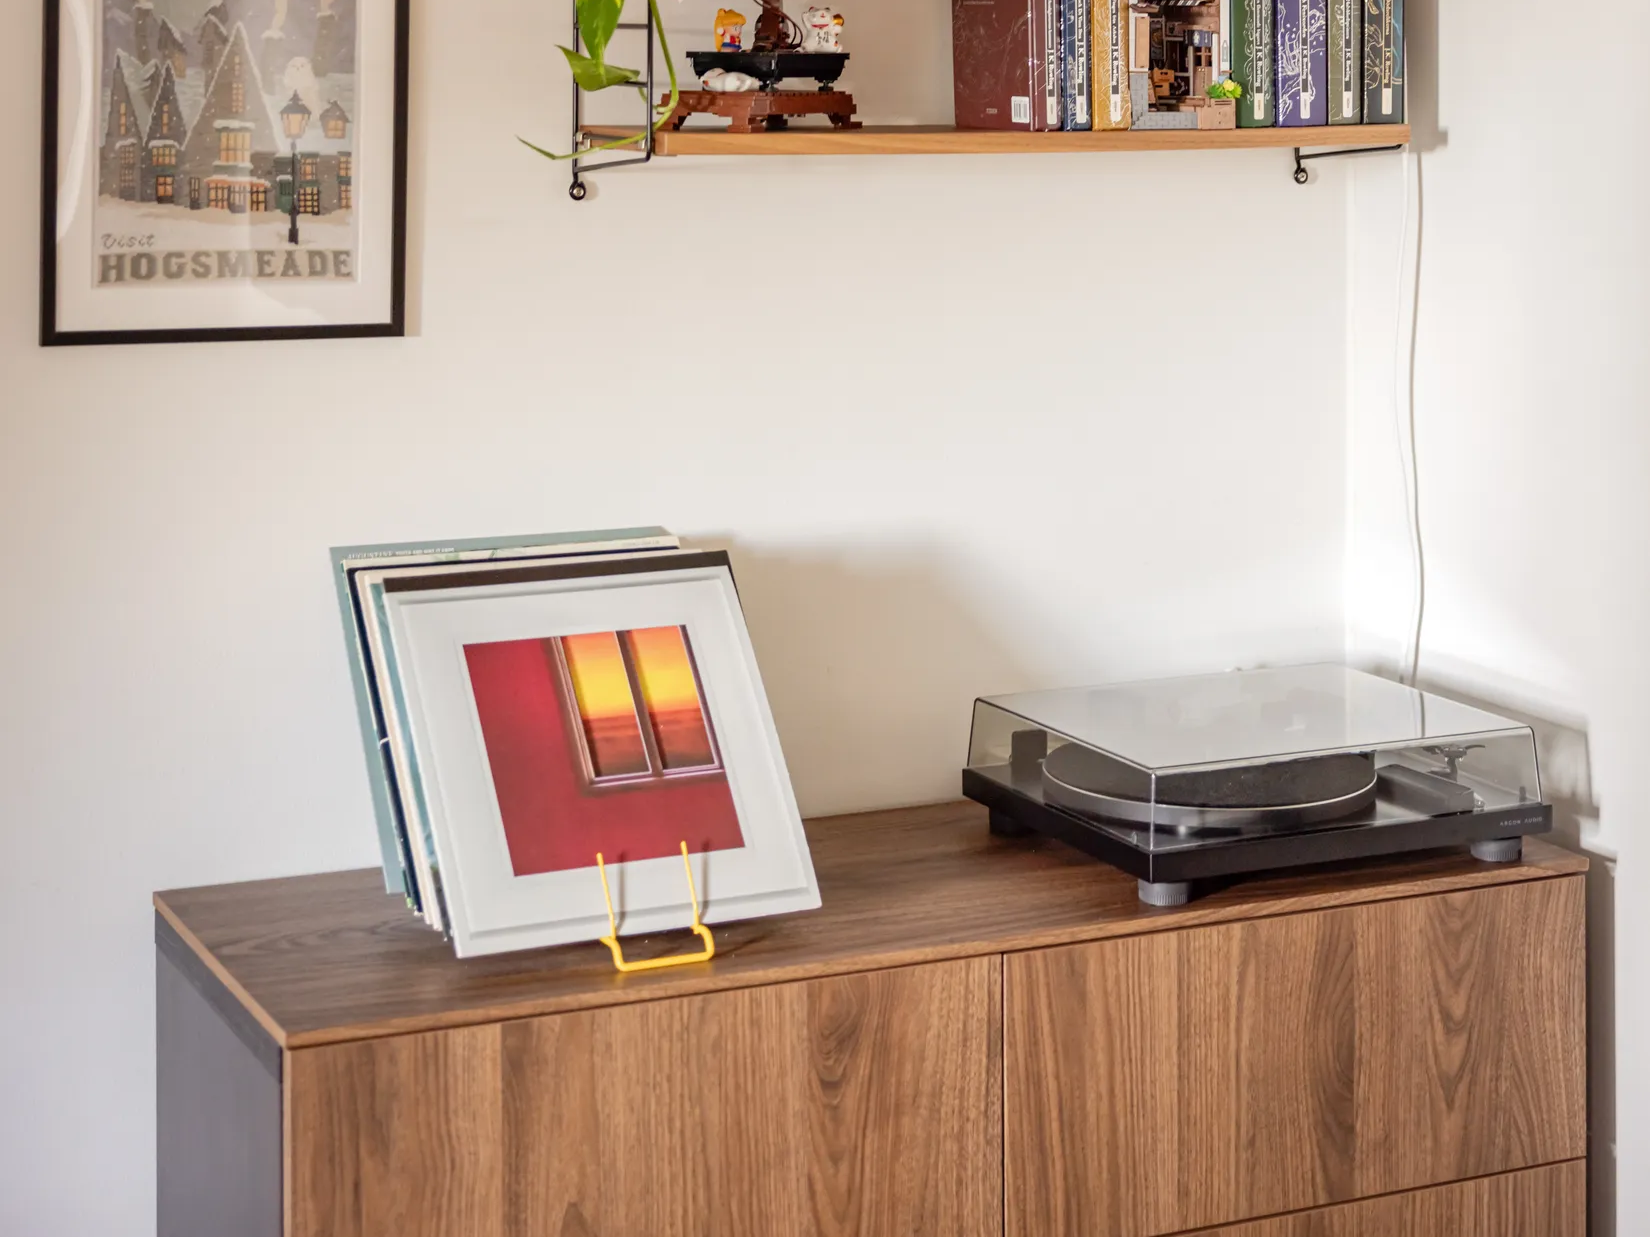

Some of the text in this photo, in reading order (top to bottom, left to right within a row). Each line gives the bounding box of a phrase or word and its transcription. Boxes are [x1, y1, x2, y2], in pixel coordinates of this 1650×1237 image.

[1047, 63, 1055, 90] Rowling
[1077, 56, 1085, 84] Rowling
[1111, 60, 1119, 86] Rowling
[1255, 60, 1263, 87] Rowling
[100, 232, 155, 249] Visit
[98, 249, 352, 283] HOGSMEADE
[1524, 816, 1543, 824] AUDIO
